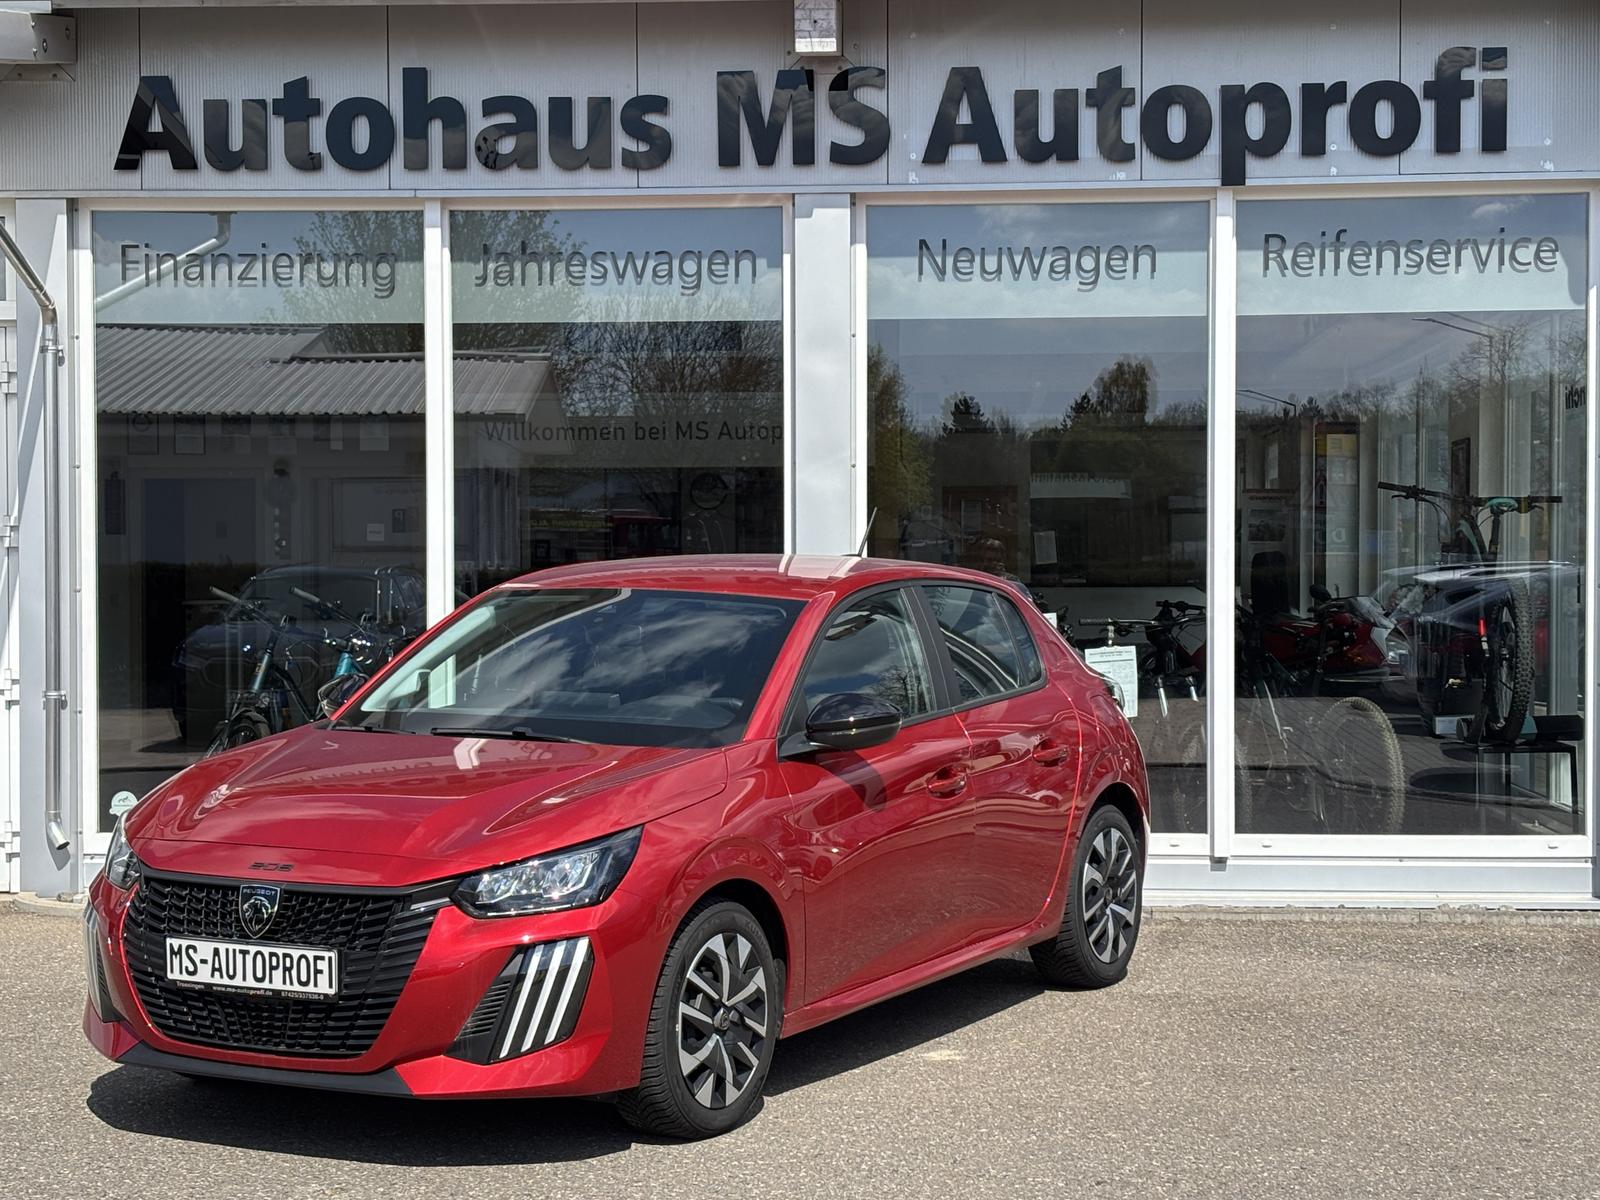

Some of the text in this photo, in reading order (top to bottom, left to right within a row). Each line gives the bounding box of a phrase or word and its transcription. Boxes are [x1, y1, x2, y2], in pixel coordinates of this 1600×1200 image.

[114, 46, 1508, 187] Autohaus MS Autoprofi
[119, 243, 397, 298] Finanzierung
[475, 240, 757, 297] Jahreswagen
[917, 237, 1157, 292] Neuwagen
[1262, 227, 1560, 277] Reifenservice
[484, 421, 625, 442] Willkommen
[634, 420, 667, 441] bei
[675, 421, 709, 440] MS
[243, 888, 276, 896] PEUGEOT
[168, 942, 333, 989] MS-AUTOPROFI
